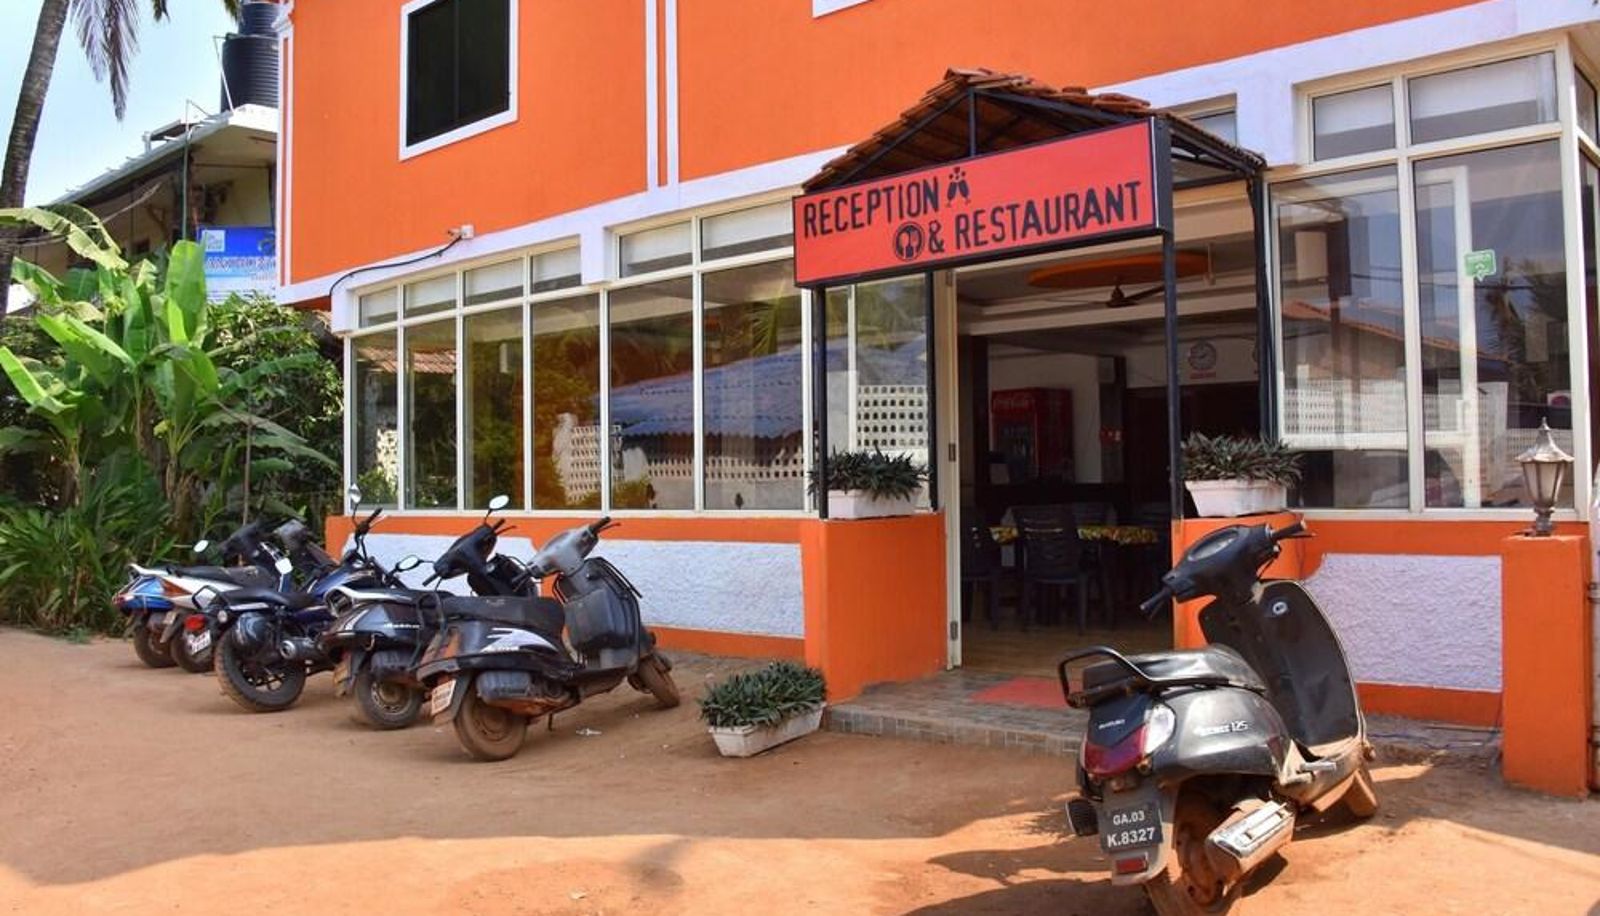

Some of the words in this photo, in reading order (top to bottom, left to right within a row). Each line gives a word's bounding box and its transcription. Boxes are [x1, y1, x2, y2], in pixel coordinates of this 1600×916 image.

[804, 177, 939, 239] RECEPTION
[928, 220, 945, 254] &
[955, 181, 1142, 250] RESTAURANT
[1107, 827, 1156, 848] K.8327
[1113, 810, 1145, 826] GA.03
